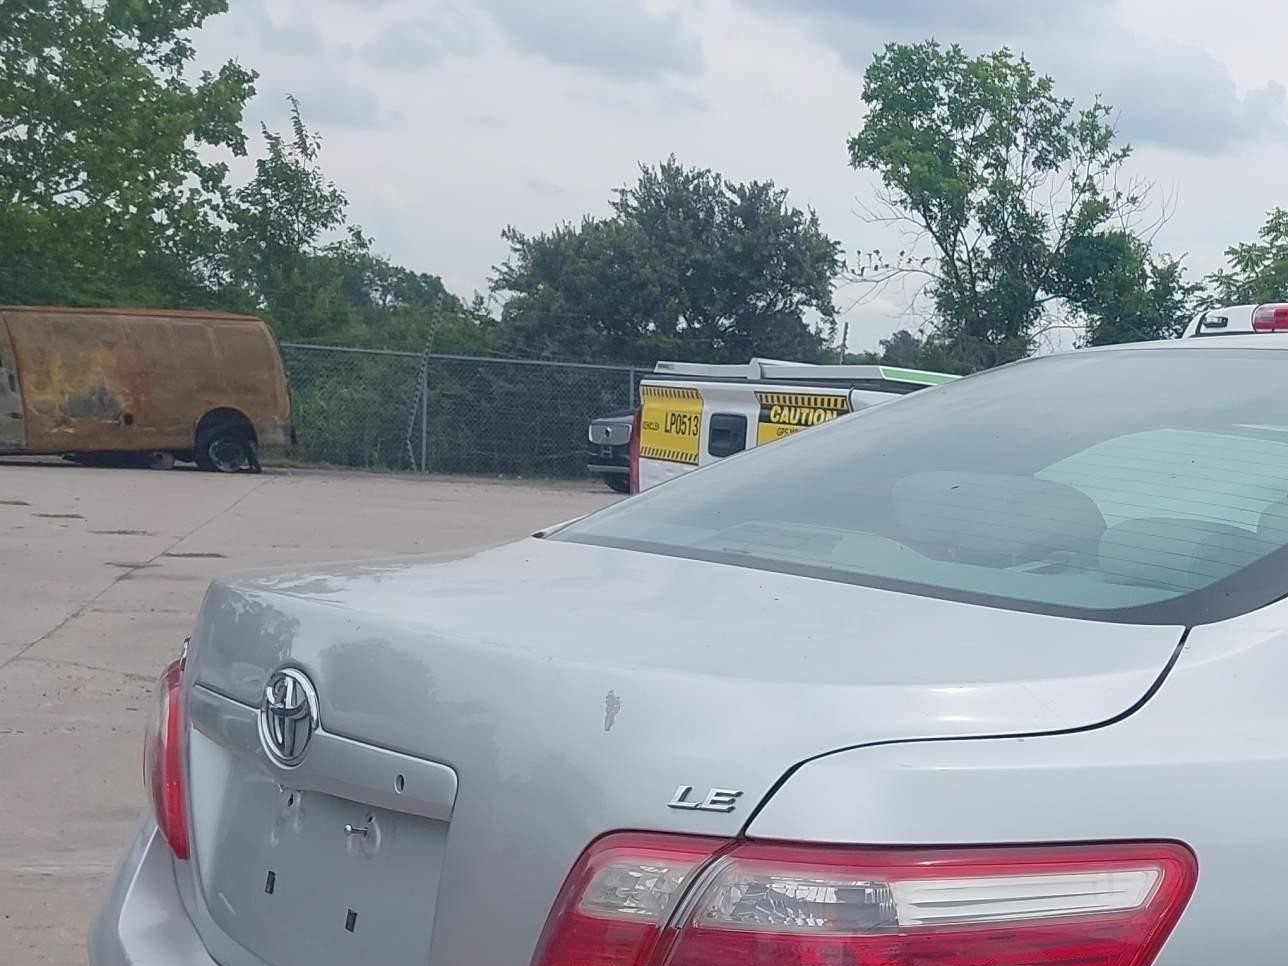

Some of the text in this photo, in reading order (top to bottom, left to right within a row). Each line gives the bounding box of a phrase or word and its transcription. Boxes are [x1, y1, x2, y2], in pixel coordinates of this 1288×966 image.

[664, 411, 699, 437] LP0513
[769, 405, 837, 426] CAUTION
[667, 785, 744, 814] LE
